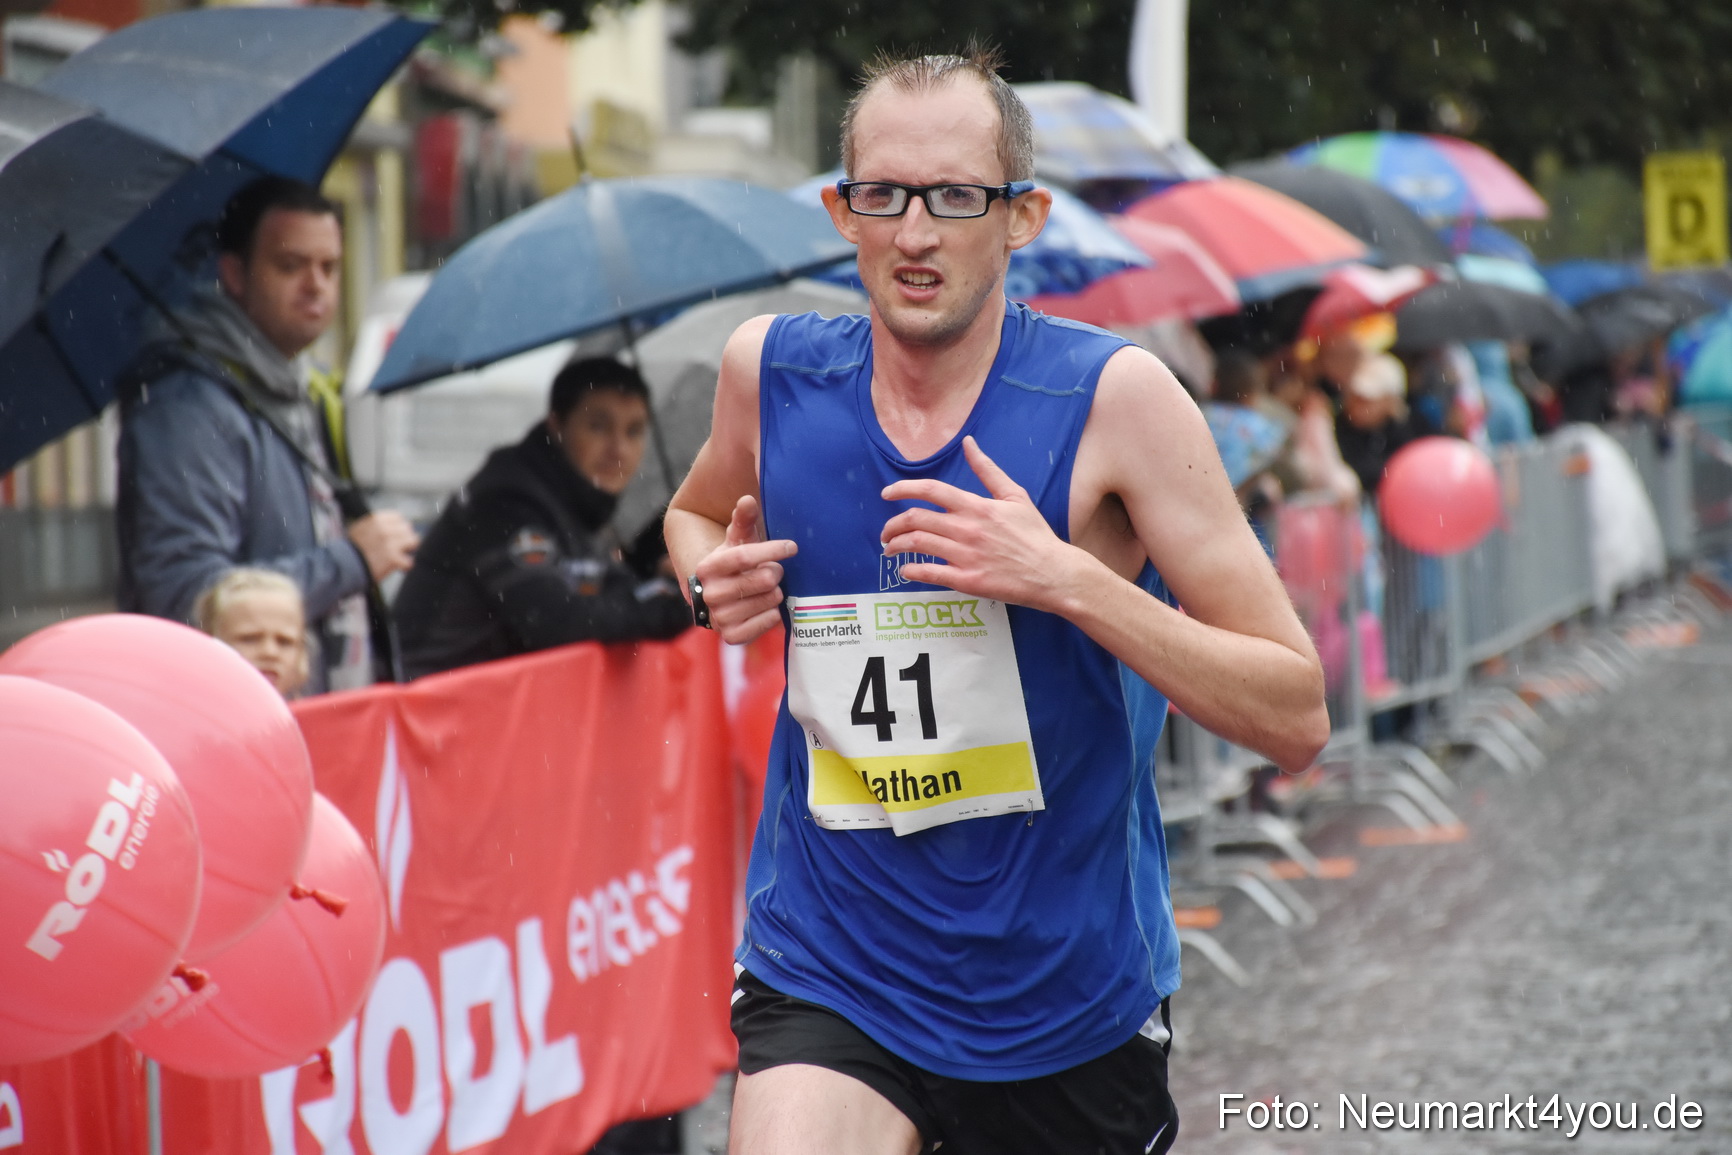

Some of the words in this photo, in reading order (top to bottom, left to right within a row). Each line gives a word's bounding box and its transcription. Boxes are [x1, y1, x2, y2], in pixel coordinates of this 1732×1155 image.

[874, 600, 986, 630] BOCK
[793, 624, 862, 638] NeuerMarkt
[876, 631, 911, 642] inspired
[912, 630, 922, 640] by
[924, 630, 949, 639] smart
[951, 629, 988, 639] concepts
[850, 653, 938, 742] 41
